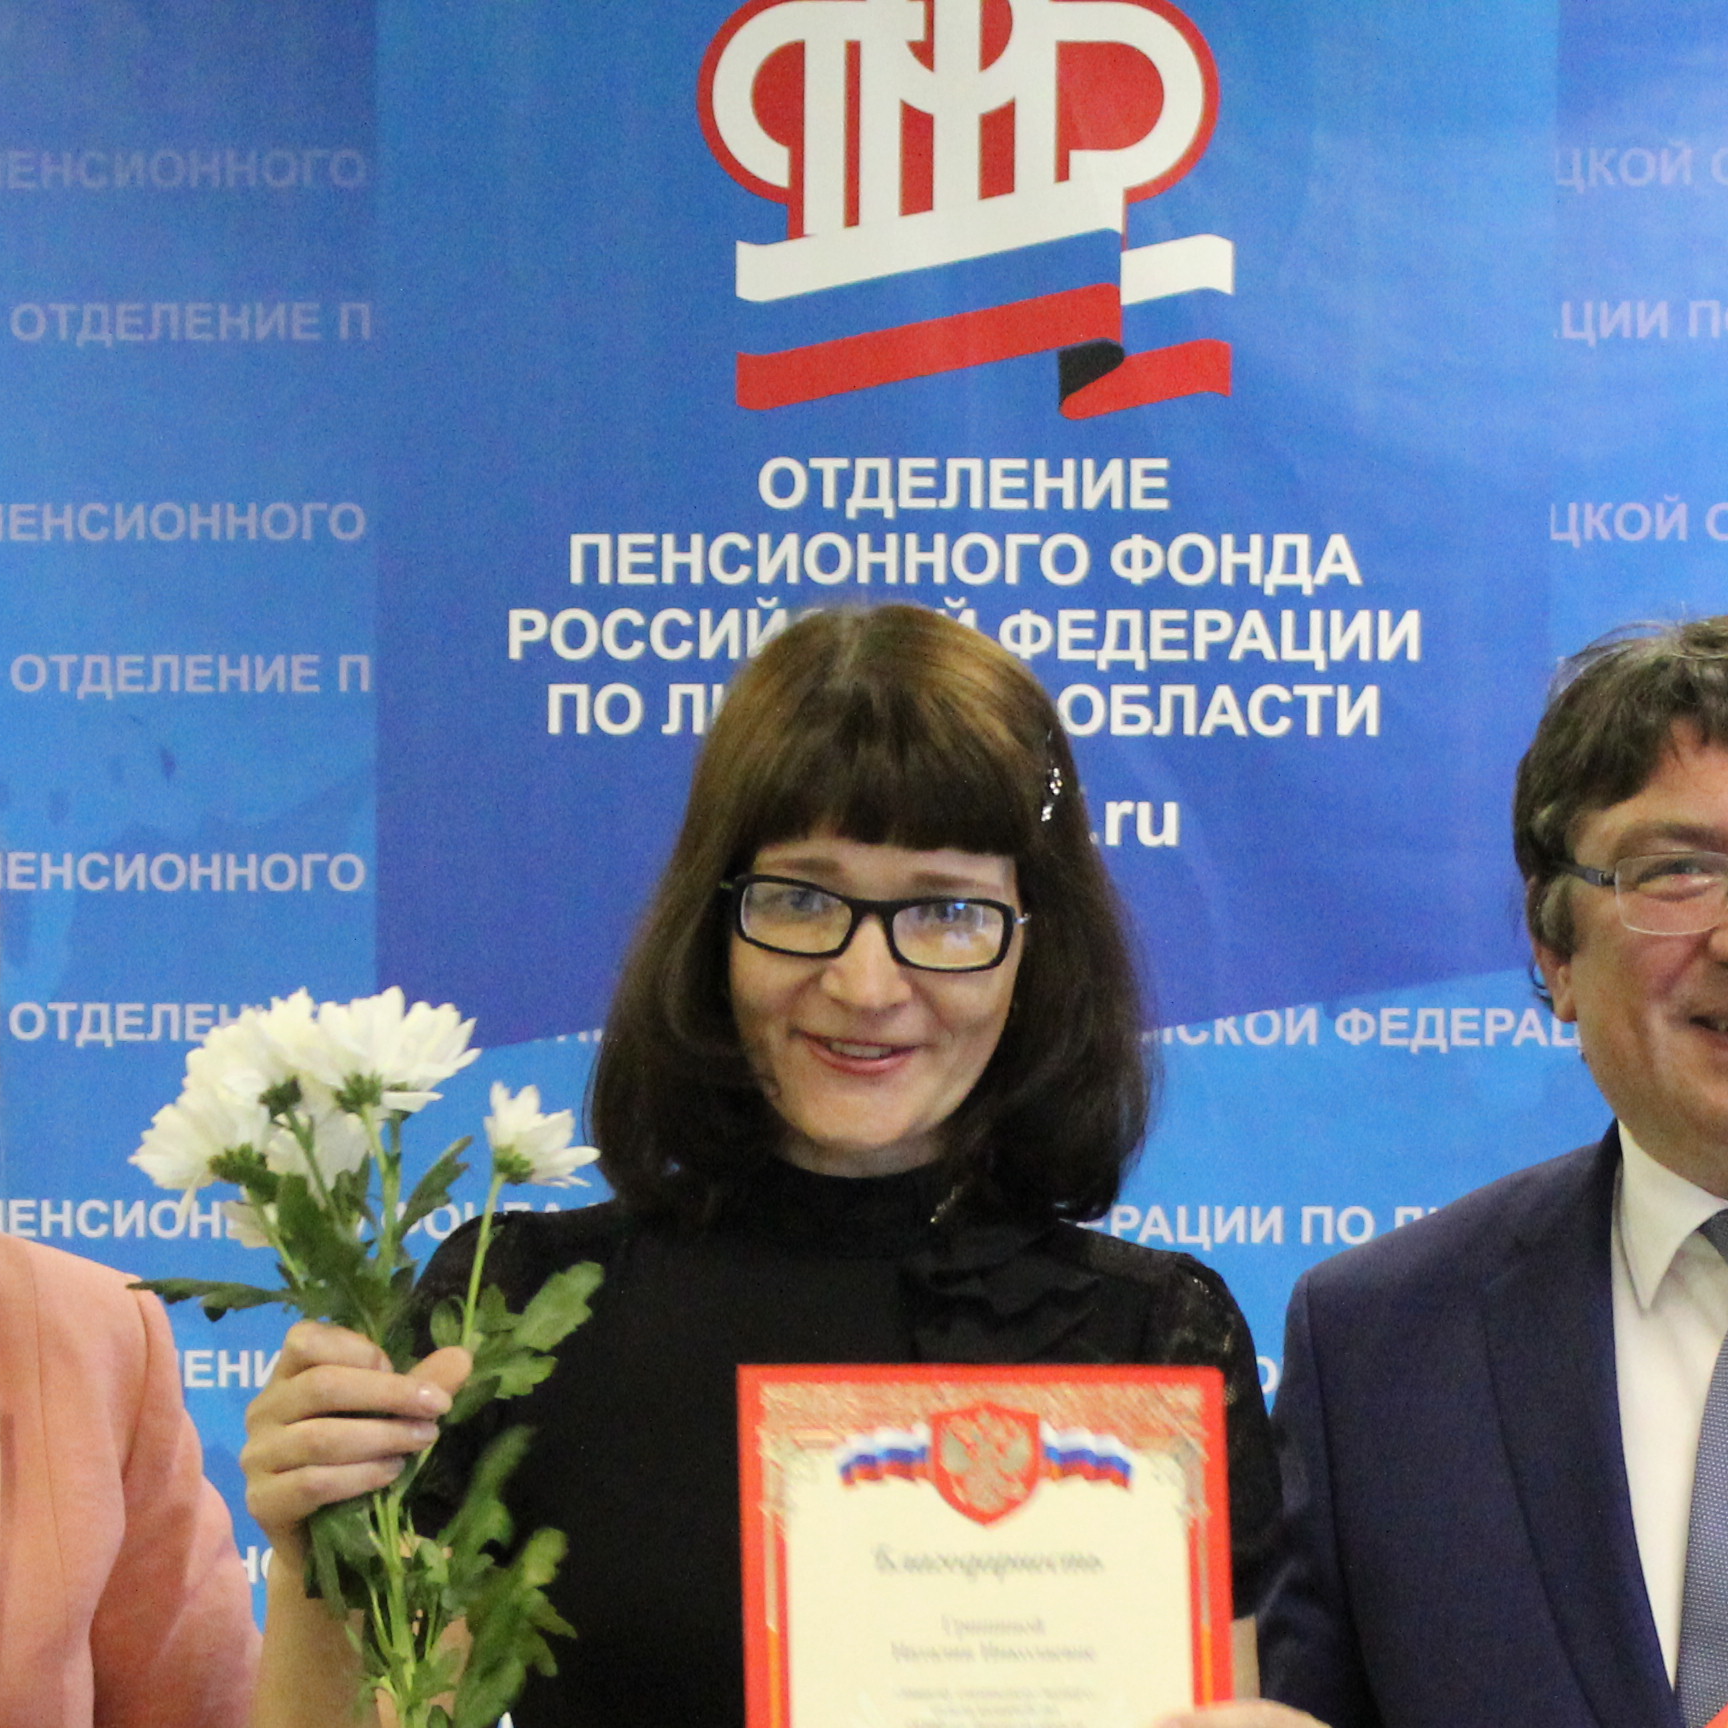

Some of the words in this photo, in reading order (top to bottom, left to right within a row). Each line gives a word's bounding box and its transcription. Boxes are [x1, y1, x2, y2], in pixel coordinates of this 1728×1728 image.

[10, 302, 320, 347] ОТДЕЛЕНИЕ
[758, 457, 1169, 517] ОТДЕЛЕНИЕ
[569, 533, 1089, 586] ПЕНСИОННОГО
[1110, 533, 1361, 594] ФОНДА
[999, 608, 1421, 669] ФЕДЕРАЦИИ
[10, 655, 318, 698] ОТДЕЛЕНИЕ
[547, 683, 642, 736] ПО
[1056, 683, 1380, 737] ОБЛАСТИ
[1334, 1007, 1581, 1053] ФЕДЕРАЦ
[1082, 1206, 1284, 1250] РАЦИИ
[1301, 1206, 1374, 1245] ПО
